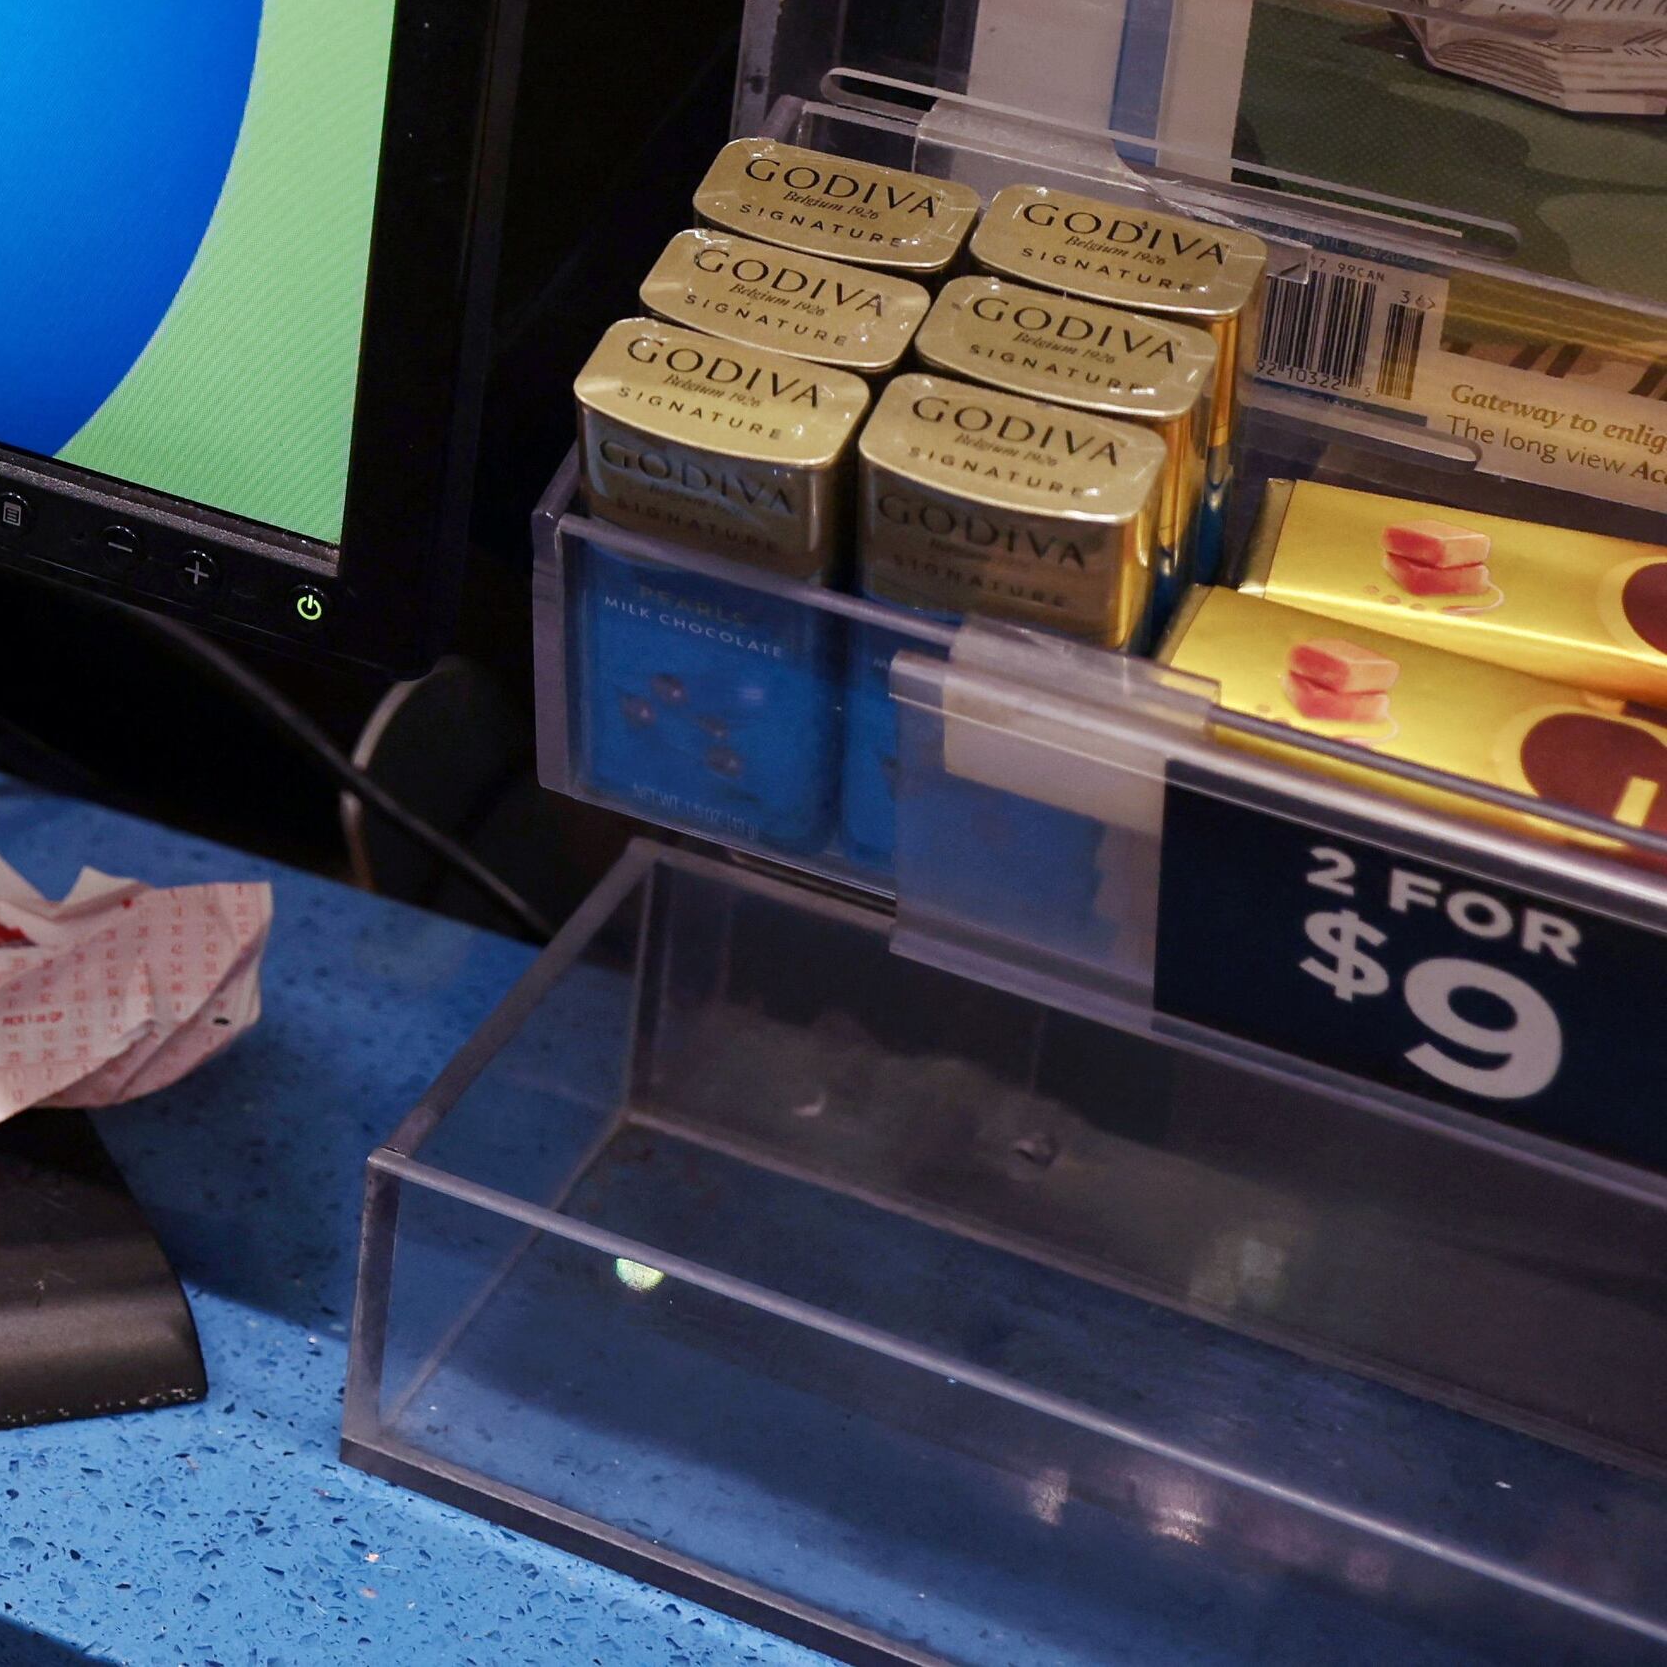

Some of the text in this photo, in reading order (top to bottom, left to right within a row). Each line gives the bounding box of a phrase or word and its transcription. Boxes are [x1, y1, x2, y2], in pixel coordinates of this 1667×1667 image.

[744, 158, 937, 219] GODIVA
[782, 191, 880, 221] Belgium 1926
[739, 203, 903, 248] SIGNATURE
[1022, 202, 1225, 266] GODIVA
[1064, 235, 1167, 266] Belgium 1926
[693, 248, 883, 319] GODIVA
[728, 283, 826, 317] Belgium 1926
[684, 293, 847, 347] SIGNATURE
[972, 296, 1176, 365] GODIVA
[627, 336, 819, 410] GODIVA
[1287, 366, 1342, 392] 10322
[617, 385, 782, 440] SIGNATURE
[911, 396, 1118, 468] GODIVA
[1450, 383, 1565, 430] Gateway
[1569, 413, 1598, 434] to
[1446, 413, 1495, 445] The
[1503, 427, 1559, 464] long
[1566, 446, 1627, 475] view
[599, 439, 795, 516] GODIVA
[878, 494, 1085, 570] GODIVA
[604, 595, 783, 659] MILK CHOCOLATE
[1304, 845, 1584, 968] 2 FOR
[1298, 907, 1564, 1101] $9
